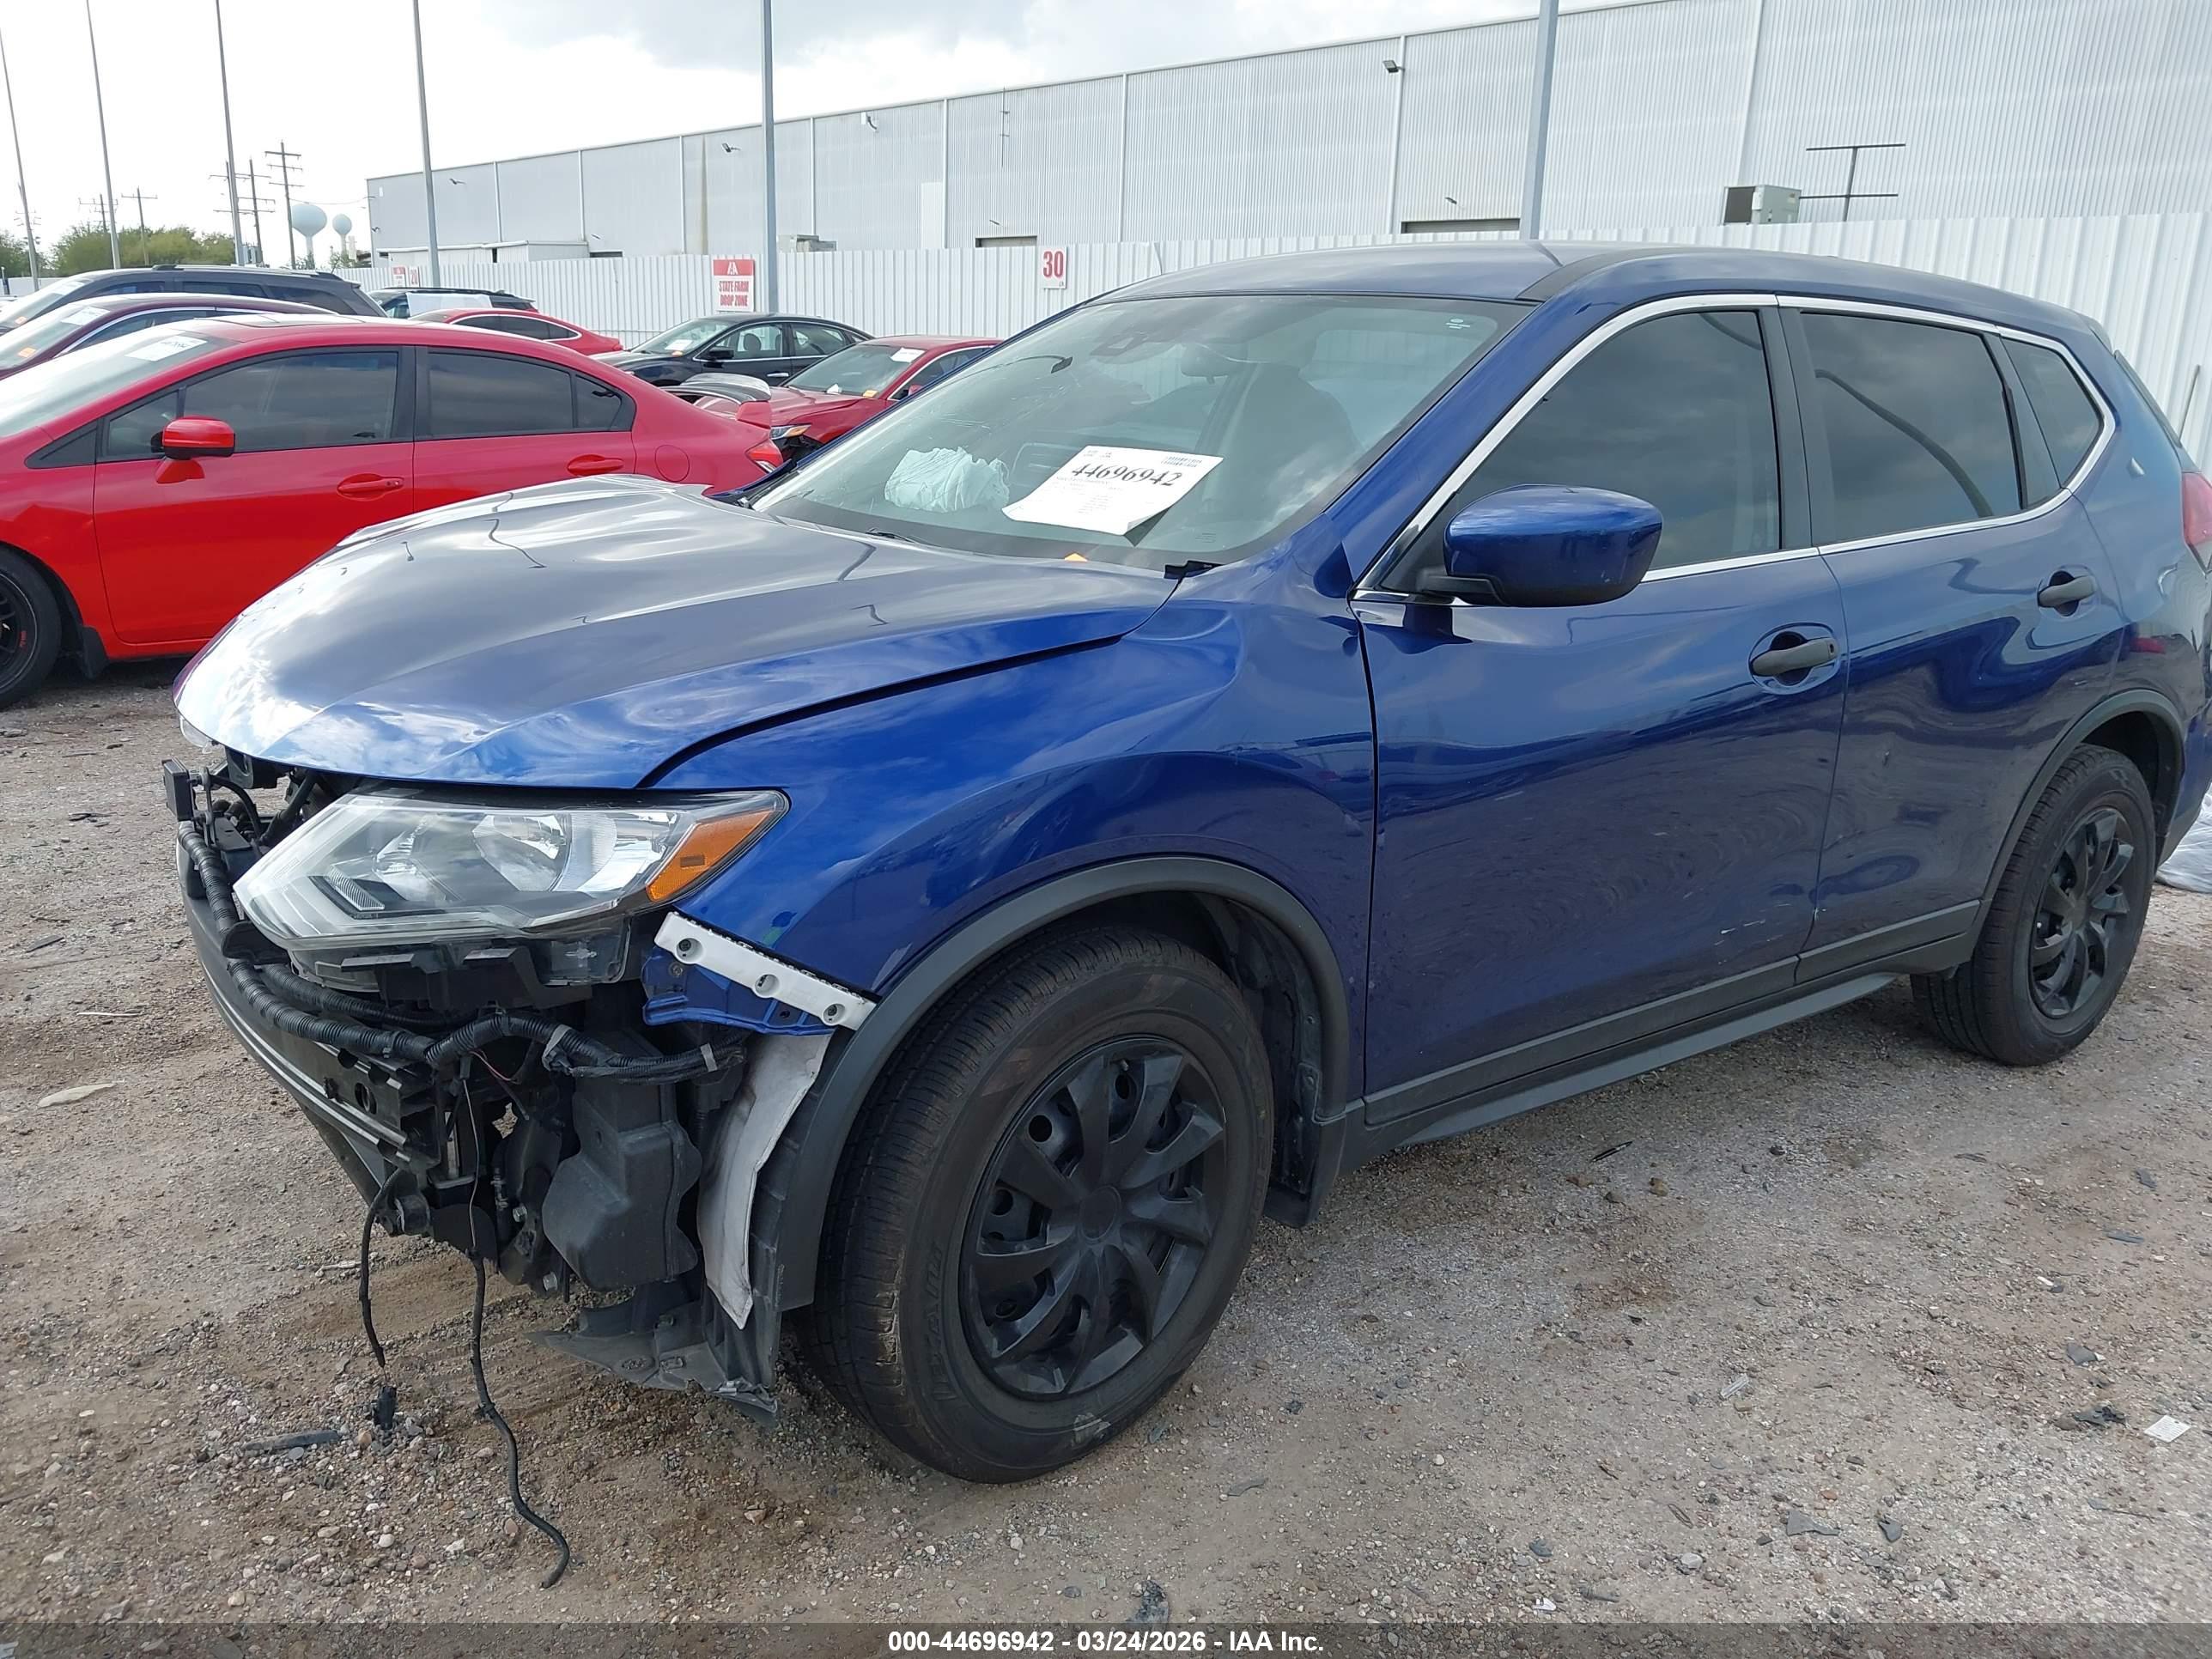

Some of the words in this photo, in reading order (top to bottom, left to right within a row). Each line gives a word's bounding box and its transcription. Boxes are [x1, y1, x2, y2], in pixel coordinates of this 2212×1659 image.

[1043, 251, 1064, 277] 30
[719, 281, 733, 292] STATE
[734, 281, 749, 292] FARM
[720, 295, 733, 307] DROP
[734, 295, 748, 307] ZONE
[1071, 463, 1182, 487] 44696942
